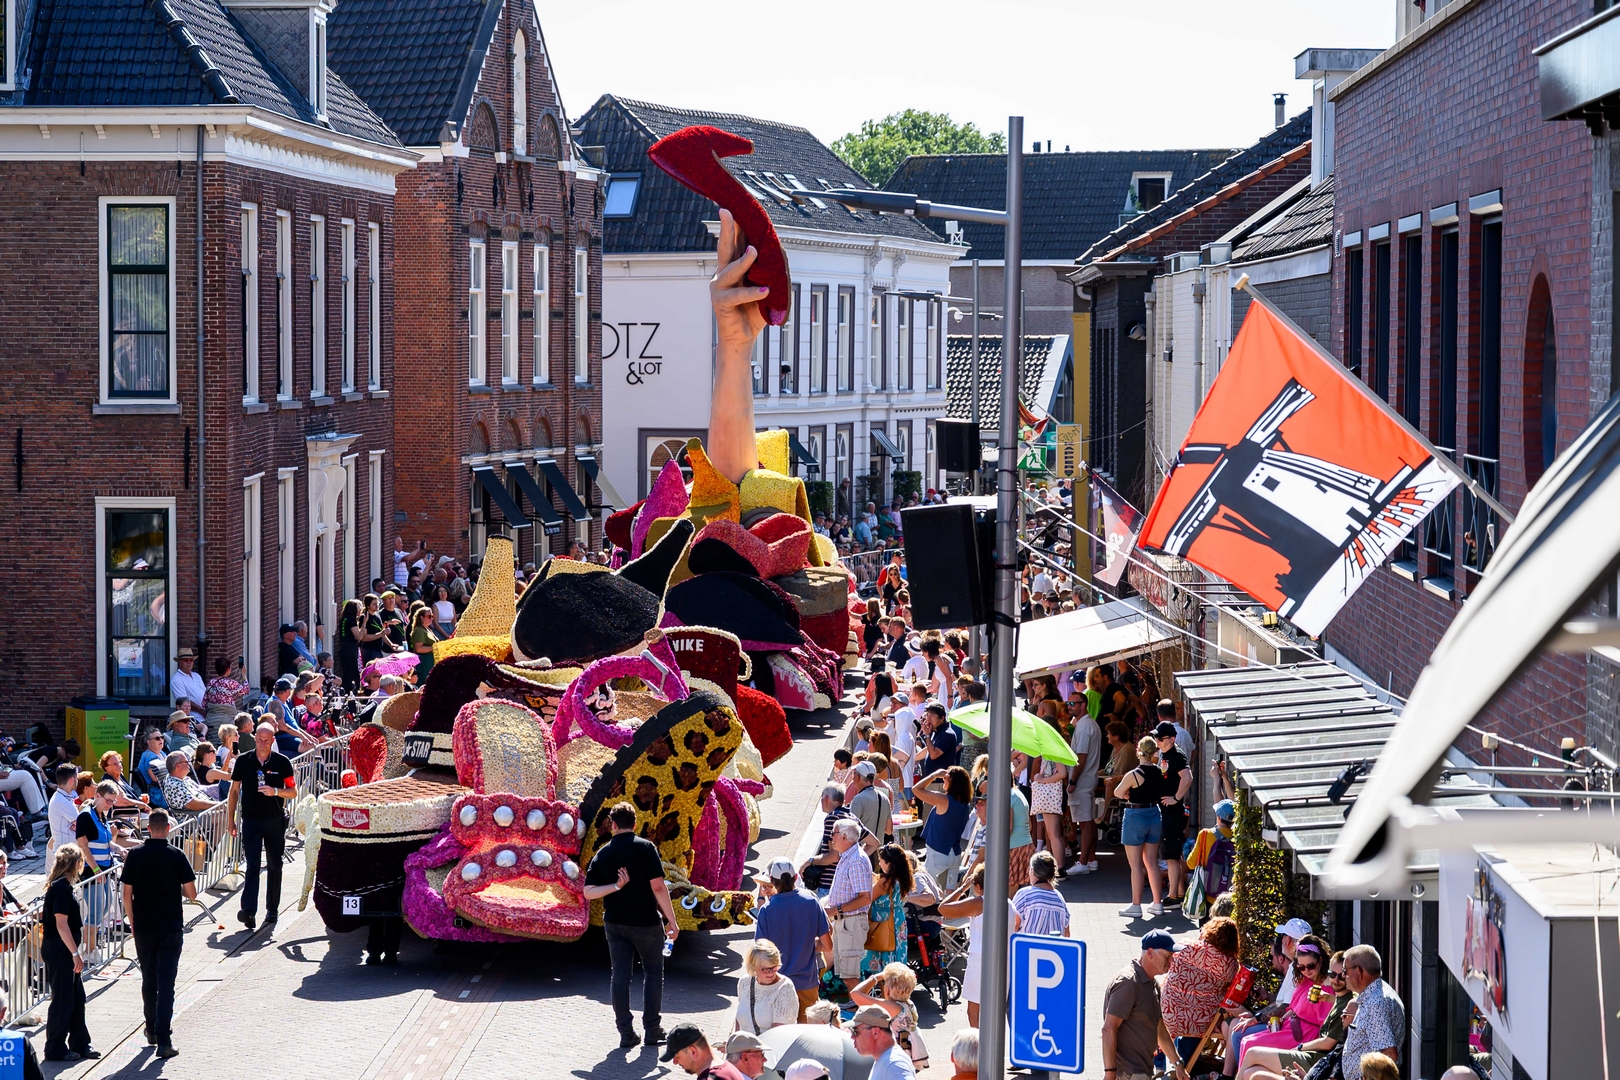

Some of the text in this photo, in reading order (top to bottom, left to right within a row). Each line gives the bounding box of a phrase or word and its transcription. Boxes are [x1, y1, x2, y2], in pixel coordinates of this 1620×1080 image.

[626, 361, 663, 385] & LOT
[411, 741, 430, 758] STAR
[344, 899, 358, 909] 13
[1028, 948, 1065, 1011] P
